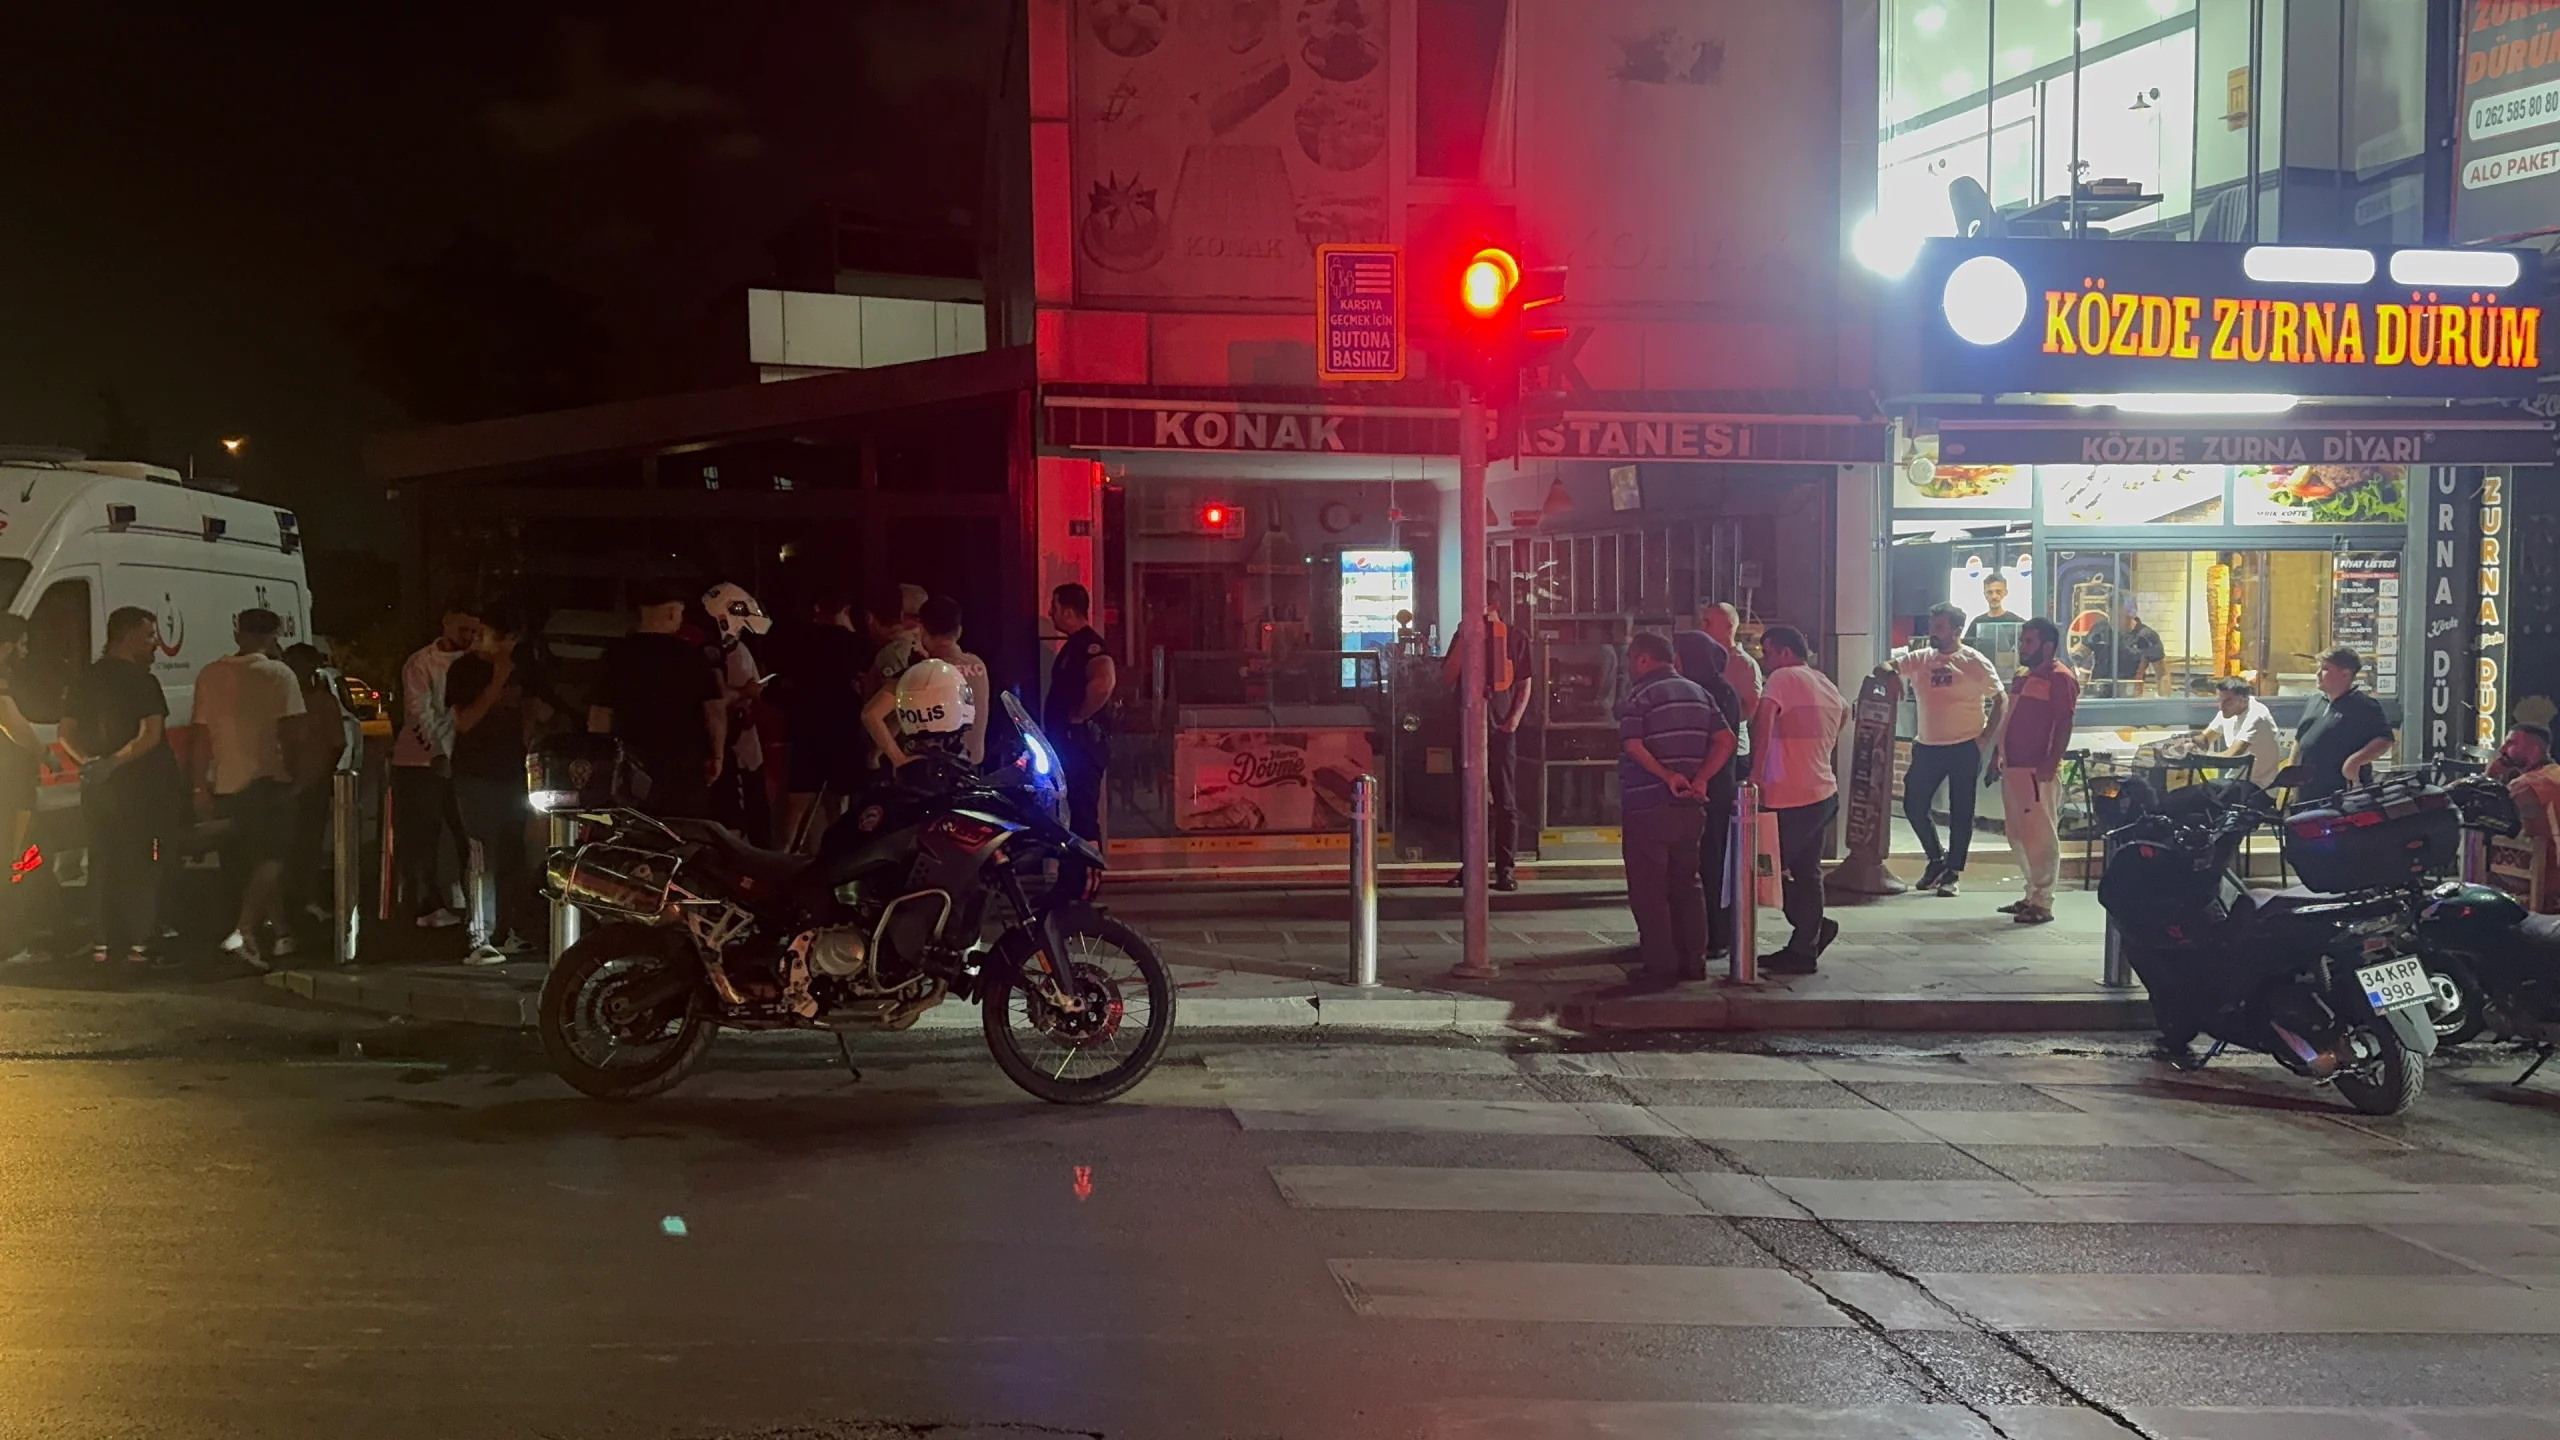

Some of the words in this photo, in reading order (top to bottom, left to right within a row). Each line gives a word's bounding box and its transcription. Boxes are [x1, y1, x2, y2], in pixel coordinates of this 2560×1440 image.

[2475, 110, 2482, 129] 0
[2485, 104, 2503, 128] 262
[2507, 99, 2526, 122] 585
[2528, 95, 2541, 117] 80
[2545, 91, 2559, 112] 80
[2470, 161, 2502, 184] ALO
[2507, 149, 2559, 176] PAKET
[1330, 315, 1370, 327] GEÇMEK
[1373, 313, 1392, 327] İÇİN
[1340, 300, 1382, 312] KARŞIYA
[2043, 277, 2200, 359] KÖZDE
[2210, 298, 2365, 363] ZURNA
[2375, 291, 2541, 369] DÜRÜM
[1332, 331, 1390, 348] BUTONA
[1333, 350, 1390, 367] BASINIZ
[1155, 411, 1345, 450] KONAK
[2082, 432, 2185, 461] KÖZDE
[2202, 437, 2306, 461] ZURNA
[2340, 557, 2364, 568] FİYAT
[2365, 557, 2396, 568] LİSTESİ
[2479, 477, 2502, 625] ZURNA
[1228, 752, 1306, 786] Dövme
[2361, 969, 2385, 988] 34
[2385, 961, 2417, 981] KRP
[2382, 981, 2415, 1002] 998
